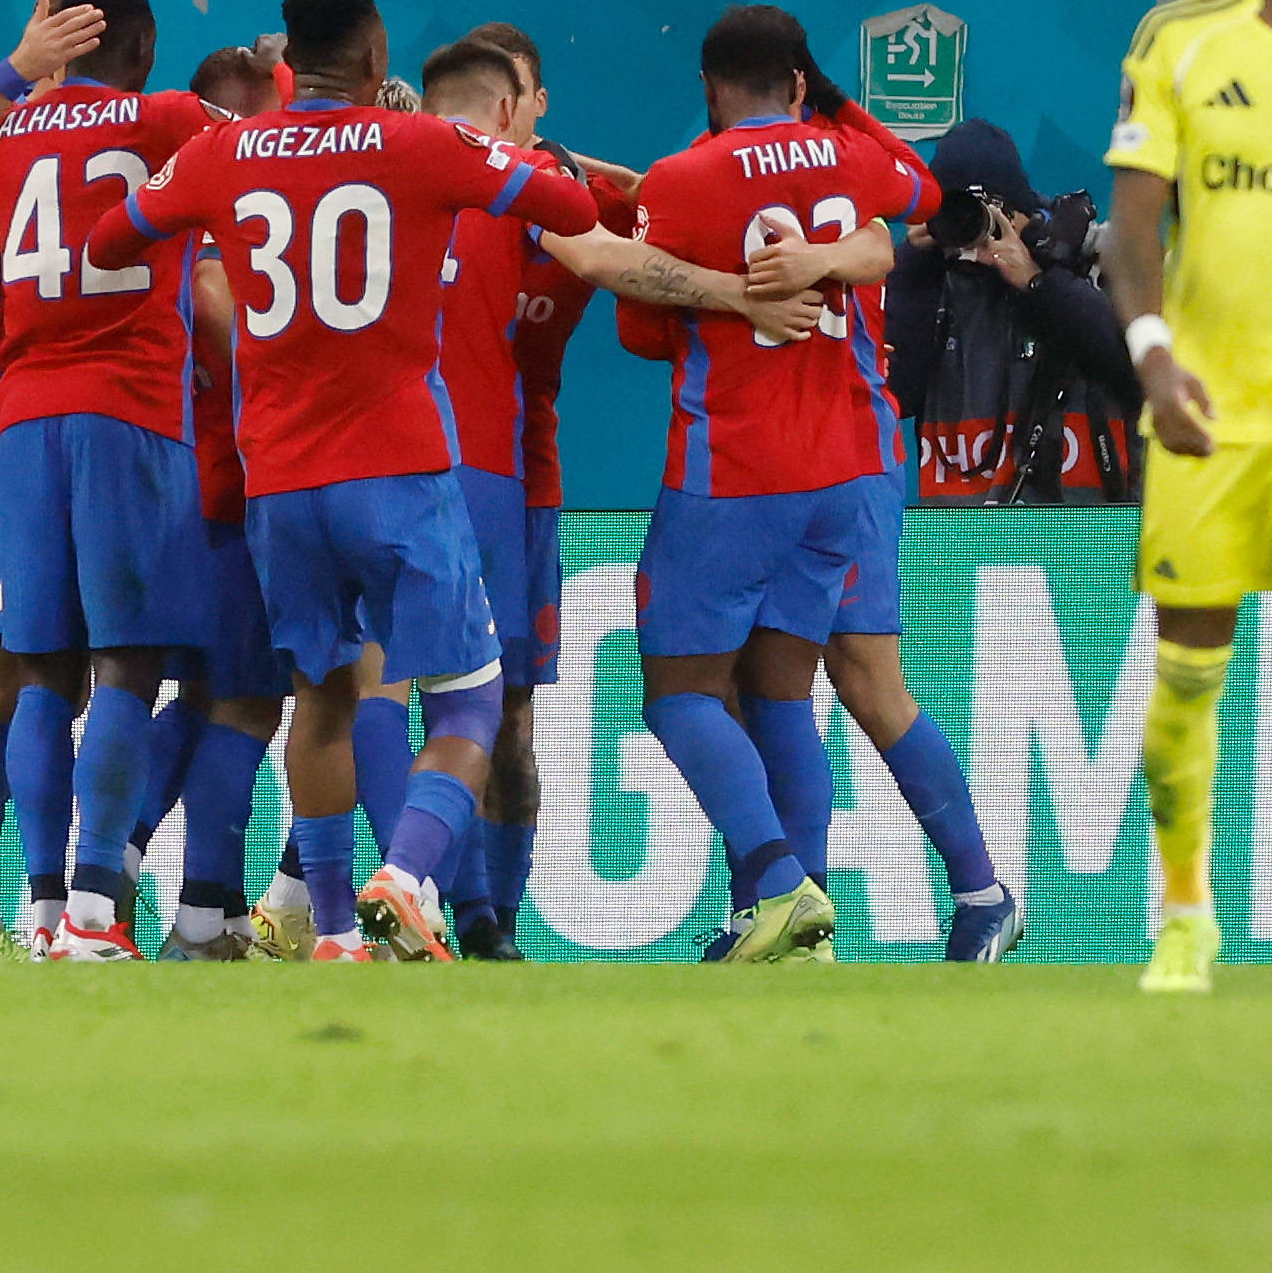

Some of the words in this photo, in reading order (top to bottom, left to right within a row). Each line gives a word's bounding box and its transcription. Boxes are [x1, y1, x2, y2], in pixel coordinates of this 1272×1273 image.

[236, 122, 383, 160] NGEZANA
[732, 138, 837, 178] THIAM
[2, 148, 151, 300] 42
[233, 183, 392, 338] 30
